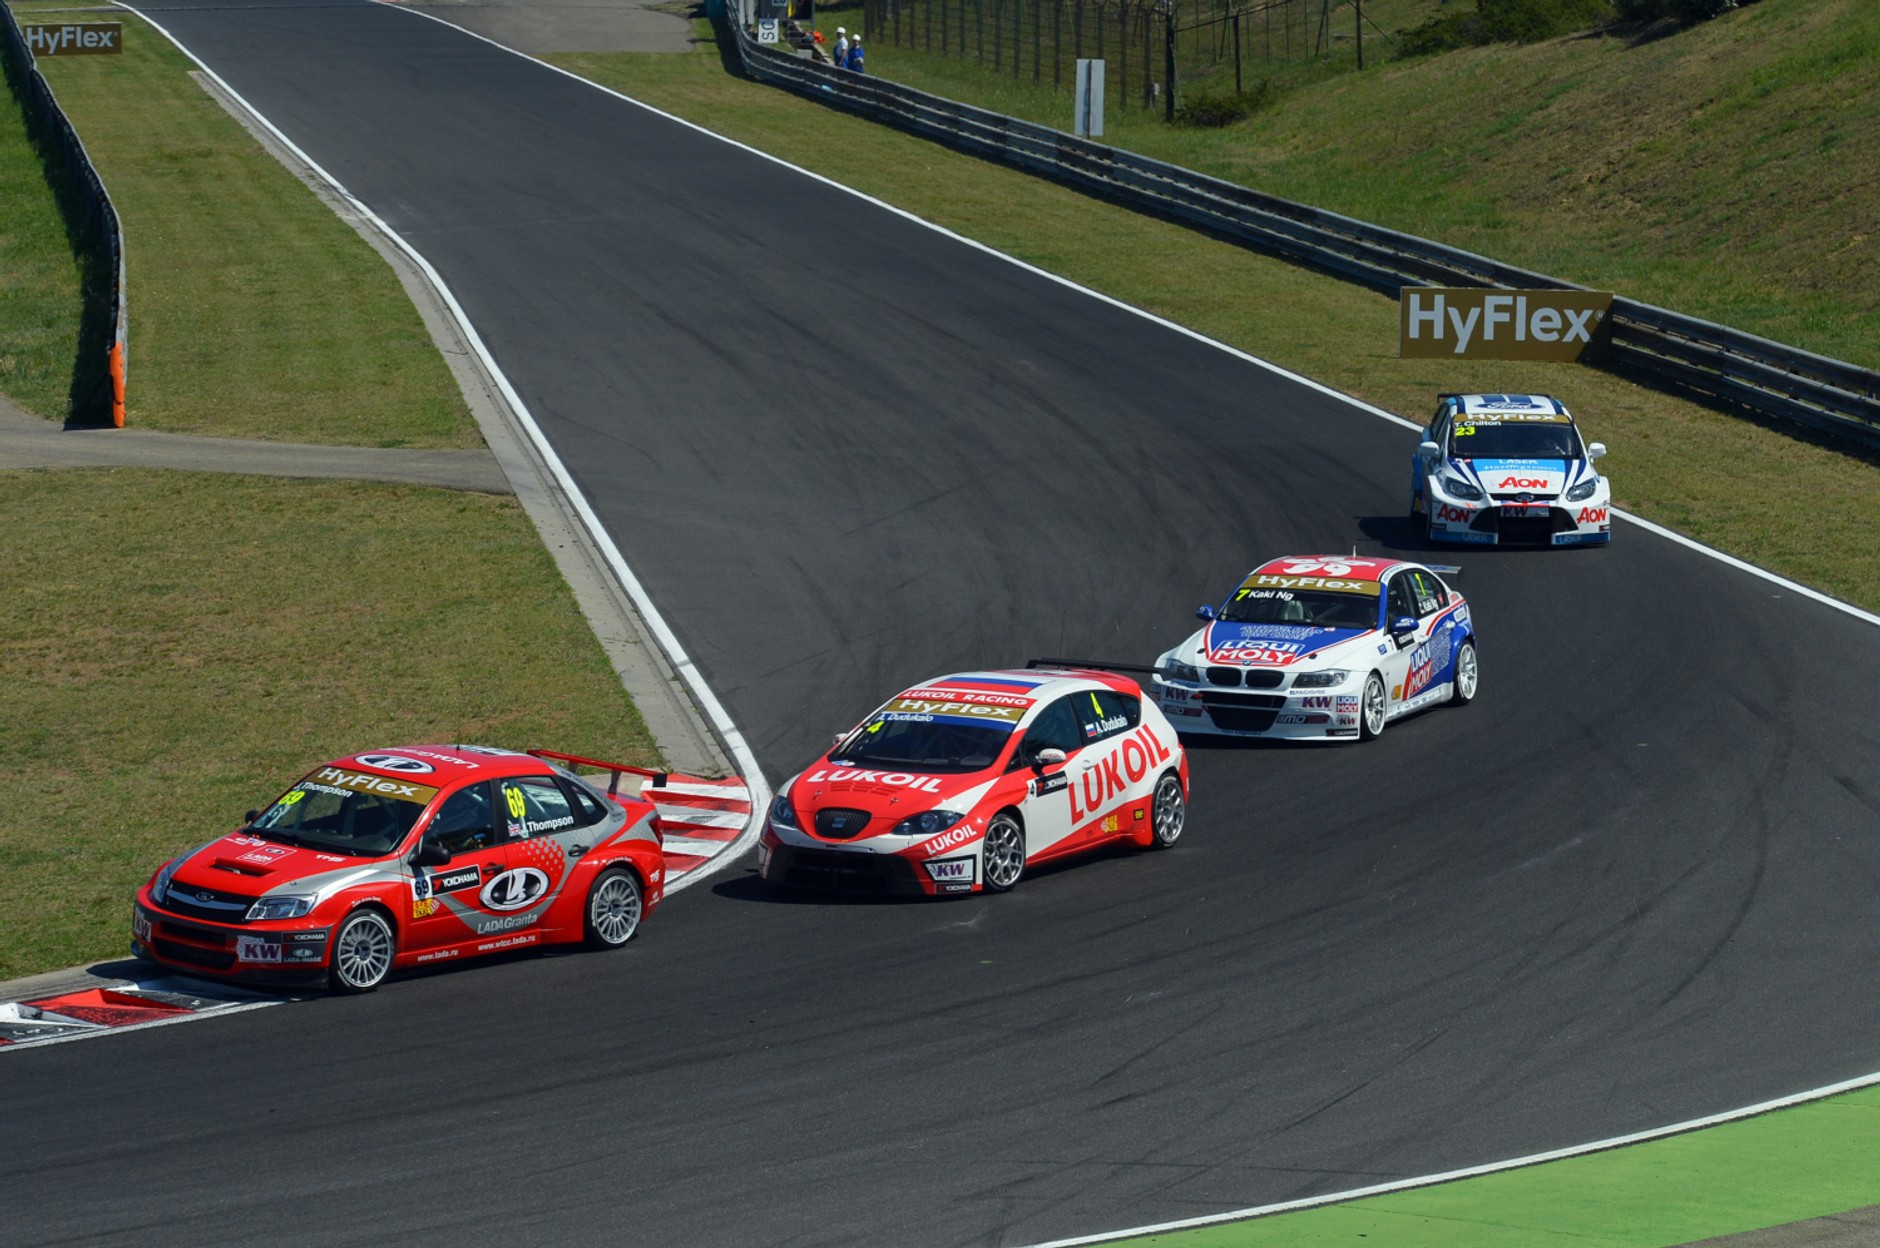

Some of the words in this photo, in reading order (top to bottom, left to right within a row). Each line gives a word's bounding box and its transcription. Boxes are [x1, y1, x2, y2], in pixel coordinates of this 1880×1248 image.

[761, 20, 775, 40] SC
[26, 27, 113, 54] HyFlex
[1409, 294, 1594, 354] HyFlex
[1467, 413, 1556, 421] HyFlex
[1456, 426, 1476, 437] 23
[1499, 477, 1548, 489] AON
[1437, 503, 1470, 523] AON
[1577, 507, 1607, 524] AON
[1258, 576, 1364, 590] HyFlex
[1235, 589, 1251, 602] 7
[1248, 590, 1275, 600] Kaki
[1275, 591, 1295, 601] Ng
[1220, 640, 1299, 652] LIQUI
[1213, 649, 1294, 662] MOLY
[1411, 641, 1432, 673] LIQUI
[903, 690, 957, 699] LUKOIL
[963, 694, 1028, 706] RACING
[1164, 686, 1189, 701] KW
[899, 699, 1013, 717] HyFlex
[1090, 692, 1105, 718] 4
[1301, 697, 1333, 708] KW
[887, 714, 934, 722] Dudukalo
[1102, 715, 1128, 732] Dudukalo
[866, 721, 885, 734] 4
[318, 767, 416, 797] HyFlex
[807, 769, 943, 793] LUKOIL
[1067, 723, 1171, 826] LUKOIL
[302, 782, 353, 797] Thompson
[278, 791, 306, 805] 69
[506, 787, 527, 818] 69
[527, 815, 574, 833] Thompson
[925, 824, 978, 855] LUKOIL
[936, 863, 965, 877] KW
[414, 879, 431, 896] 69
[442, 873, 479, 888] YOKOHAMA
[477, 935, 537, 951] www.wtcc.lada.ru
[243, 944, 281, 959] KW
[417, 948, 459, 962] www.lada.ru
